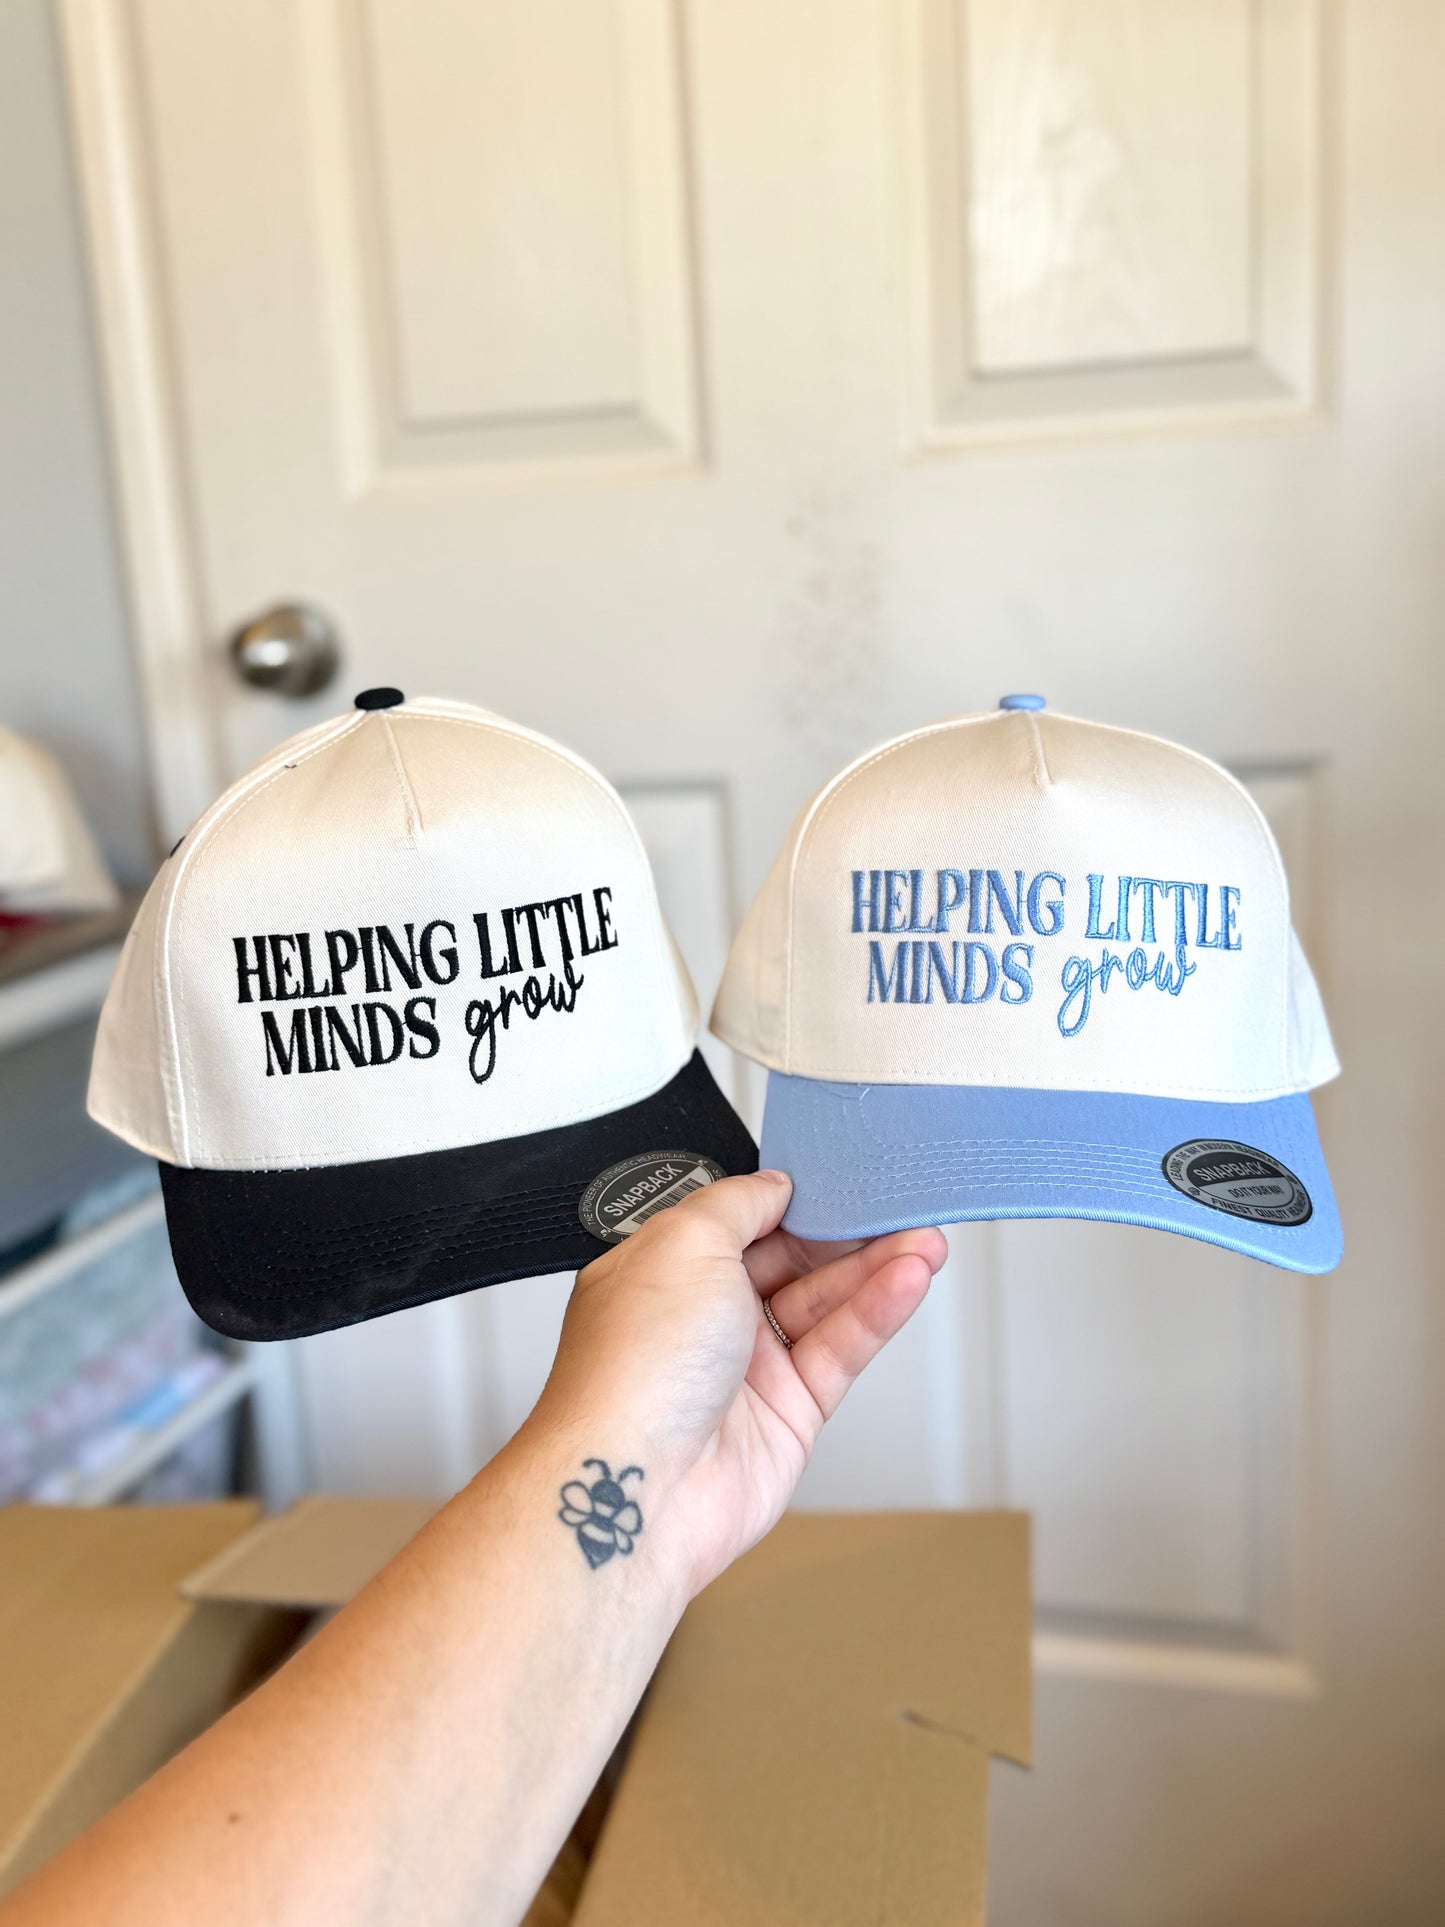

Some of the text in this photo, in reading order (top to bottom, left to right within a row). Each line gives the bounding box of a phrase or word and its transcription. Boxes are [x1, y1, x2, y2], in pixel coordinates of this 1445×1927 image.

[232, 887, 618, 1003] HELPING LITTLE
[851, 869, 1242, 950] HELPING LITTLE
[261, 960, 584, 1084] MINDS grow
[867, 940, 1196, 1038] MINDS grow
[583, 1153, 686, 1226] THE PIONEER OF AUTHENTIC HEADWEAR
[603, 1162, 684, 1217] SNAPBACK
[1193, 1161, 1272, 1182] SNAPBACK
[1211, 1198, 1253, 1216] FINEST
[1255, 1207, 1290, 1219] QUALITY
